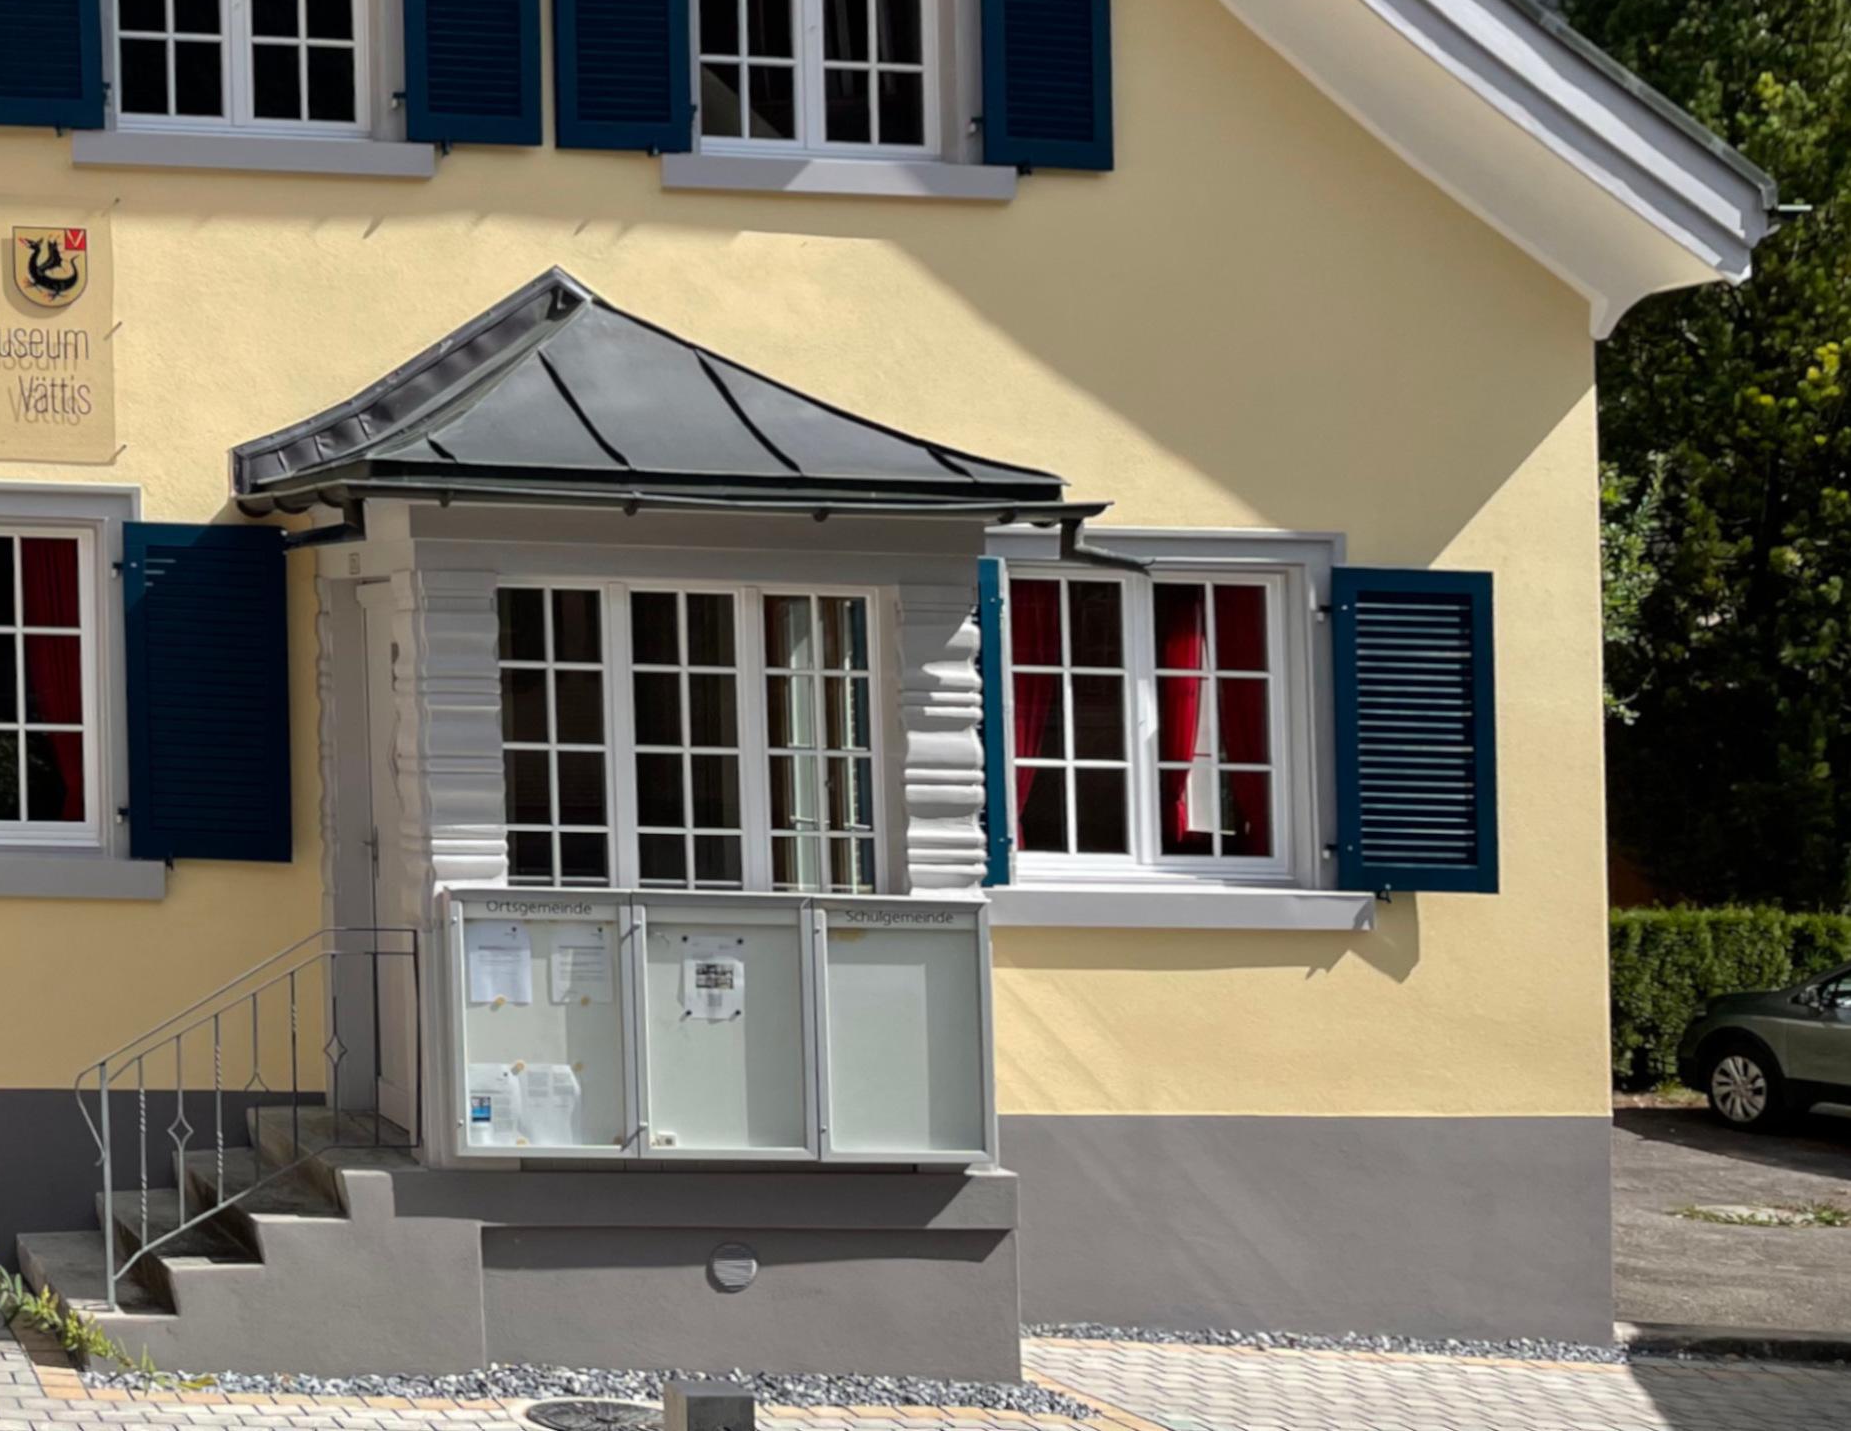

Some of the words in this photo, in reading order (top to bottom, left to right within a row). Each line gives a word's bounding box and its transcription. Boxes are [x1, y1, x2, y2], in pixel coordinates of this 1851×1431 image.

[18, 374, 92, 416] Vättis
[485, 899, 593, 917] Ortsgemeinde
[844, 909, 954, 926] Schulgemeinde
